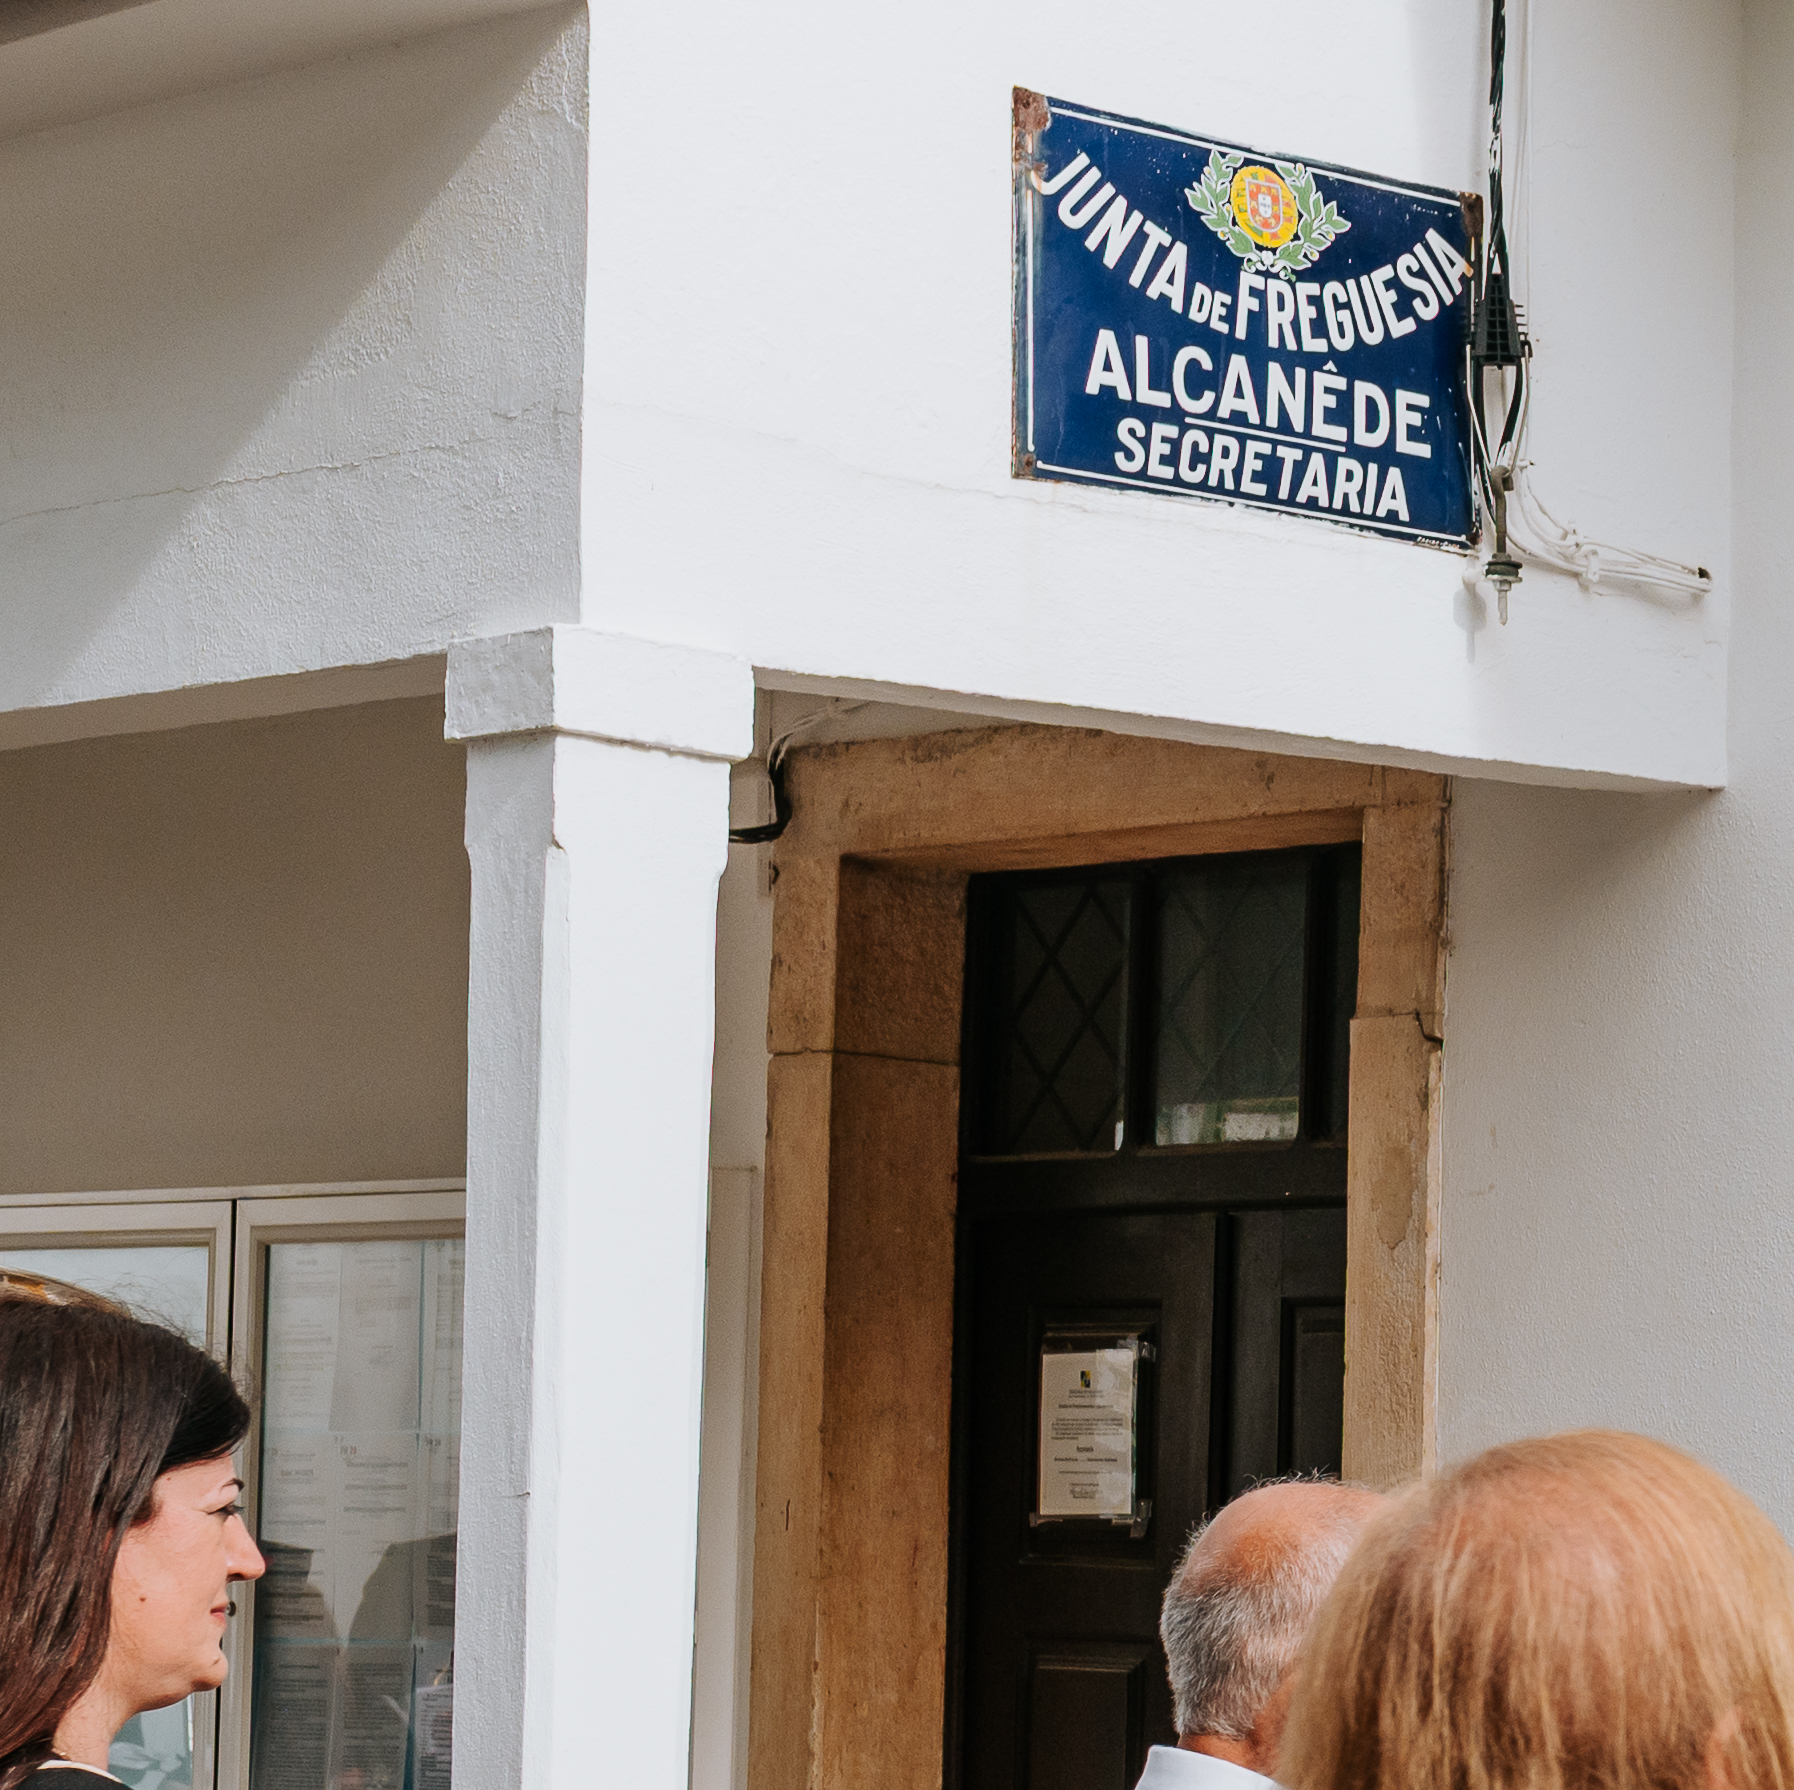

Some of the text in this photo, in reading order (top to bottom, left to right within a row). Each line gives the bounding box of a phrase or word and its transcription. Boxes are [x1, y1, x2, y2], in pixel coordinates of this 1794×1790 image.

[1030, 152, 1473, 353] JUNTA DE FREGUESIA
[1084, 328, 1432, 459] ALCANÊDE
[1114, 417, 1410, 522] SECRETARIA
